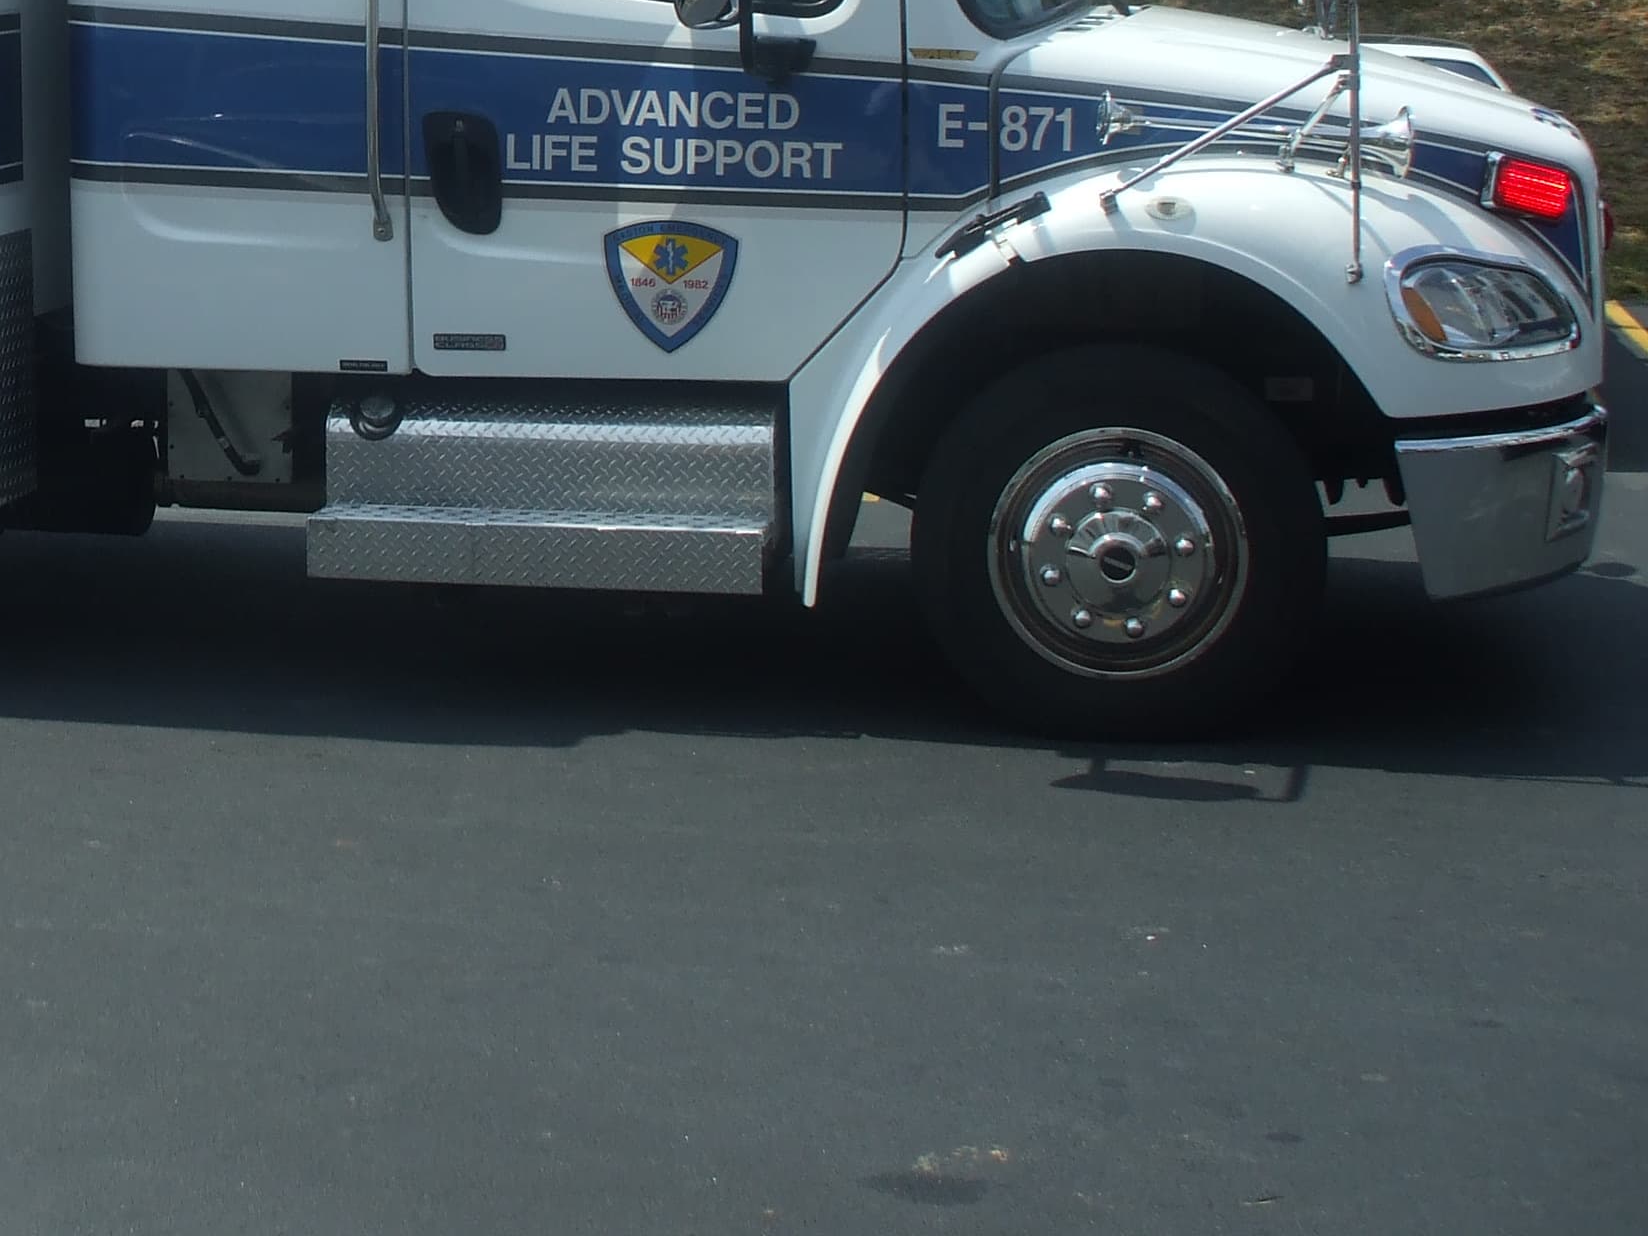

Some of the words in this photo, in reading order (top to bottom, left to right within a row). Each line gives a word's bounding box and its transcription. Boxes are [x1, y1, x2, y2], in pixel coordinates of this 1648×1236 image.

[547, 88, 800, 130] ADVANCED
[938, 104, 1072, 152] E-871
[506, 133, 599, 172] LIFE
[620, 136, 844, 179] SUPPORT
[630, 278, 656, 288] 1846
[683, 280, 709, 289] 1982
